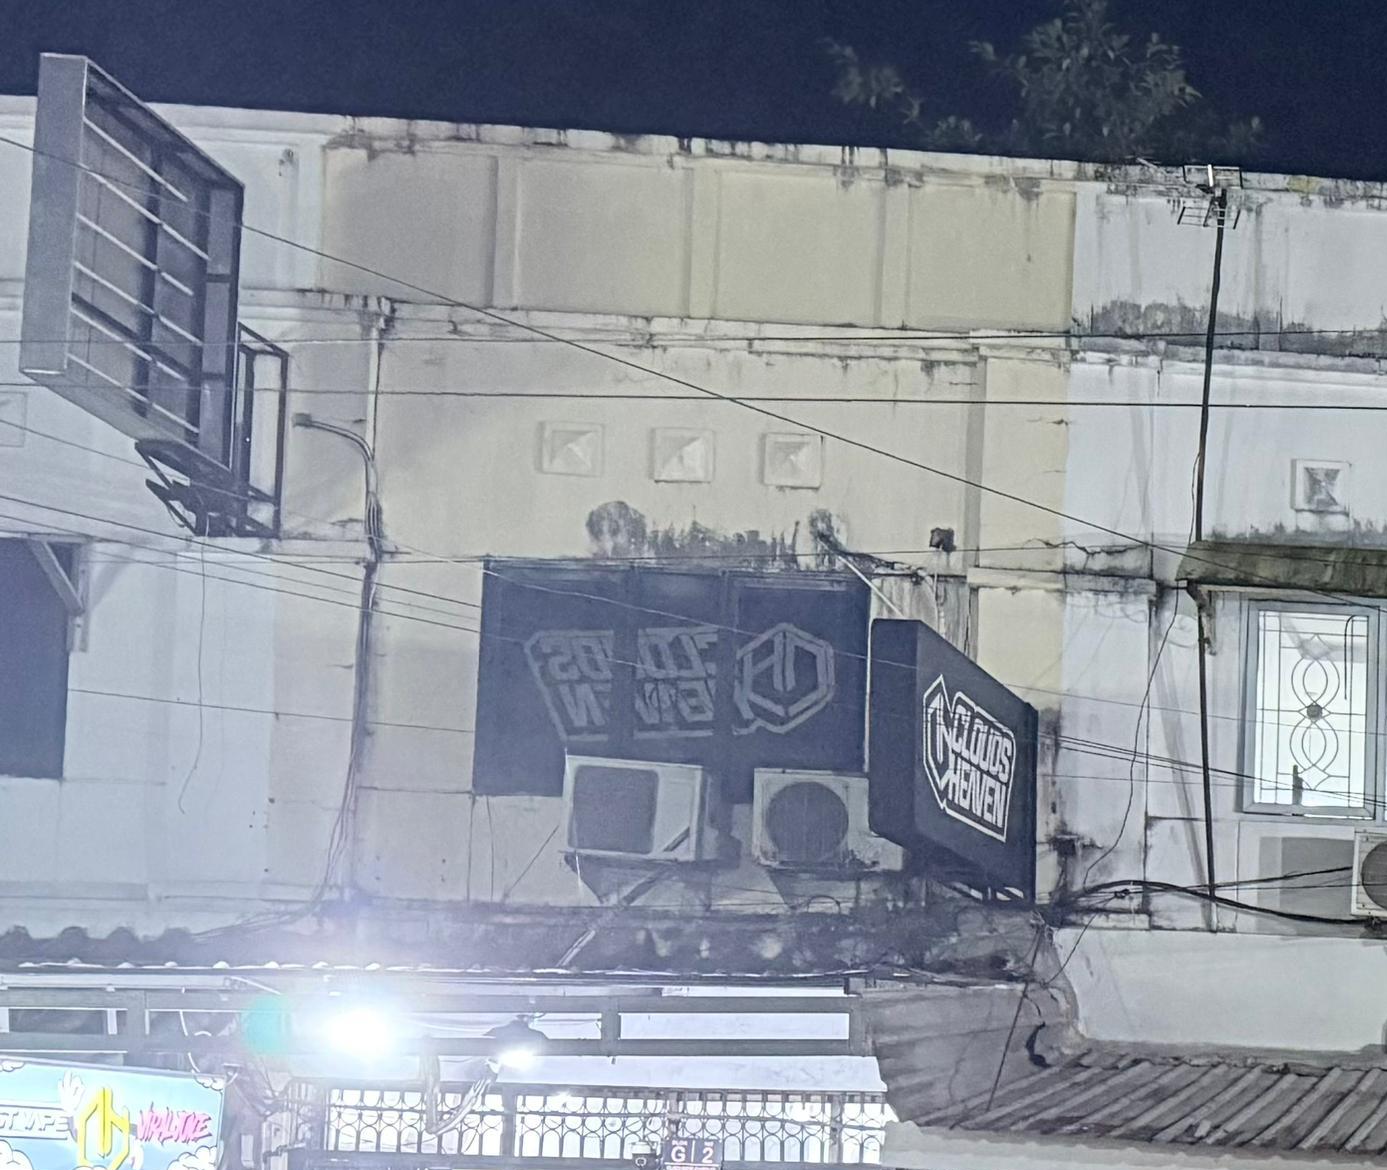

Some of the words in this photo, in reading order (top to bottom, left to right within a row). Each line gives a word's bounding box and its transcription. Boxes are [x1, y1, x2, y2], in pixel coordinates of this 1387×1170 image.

[951, 704, 1013, 783] CLOUDS
[948, 755, 1007, 828] HEAVEN
[671, 1146, 686, 1163] G
[702, 1147, 714, 1164] 2
